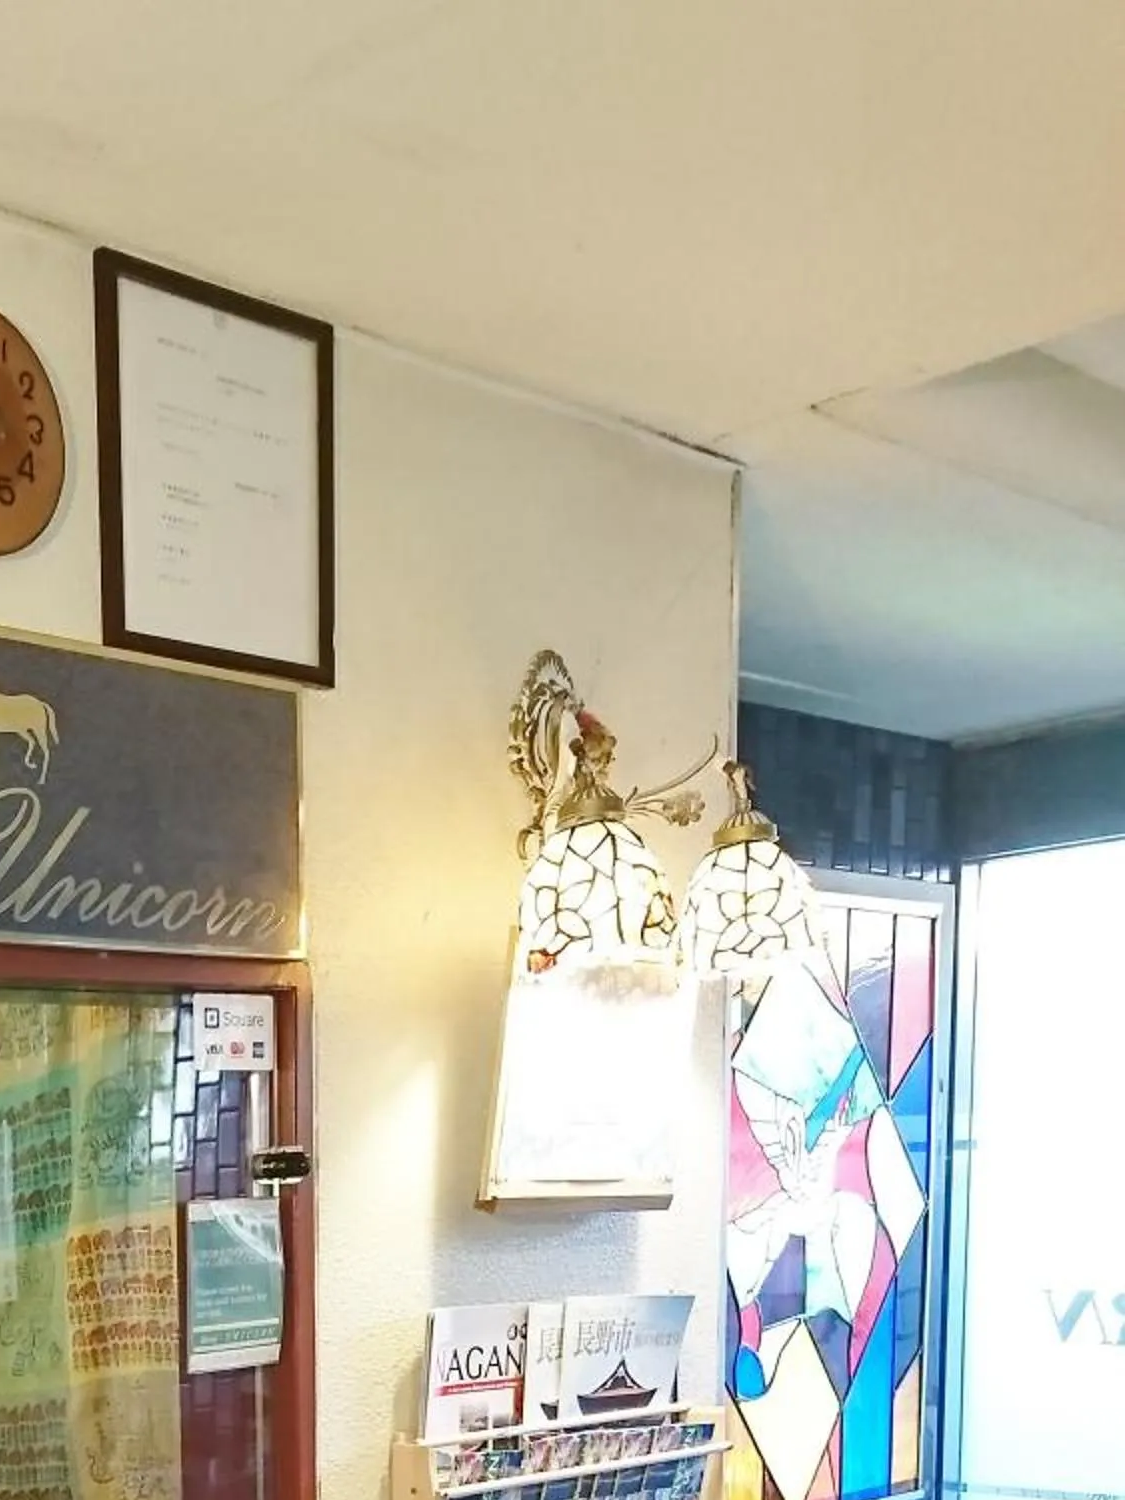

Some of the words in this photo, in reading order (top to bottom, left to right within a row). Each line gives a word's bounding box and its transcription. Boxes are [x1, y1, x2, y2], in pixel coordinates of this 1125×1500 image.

[18, 372, 36, 400] 2
[25, 415, 45, 446] 3
[16, 451, 35, 483] 4
[573, 1318, 636, 1358] 長野市
